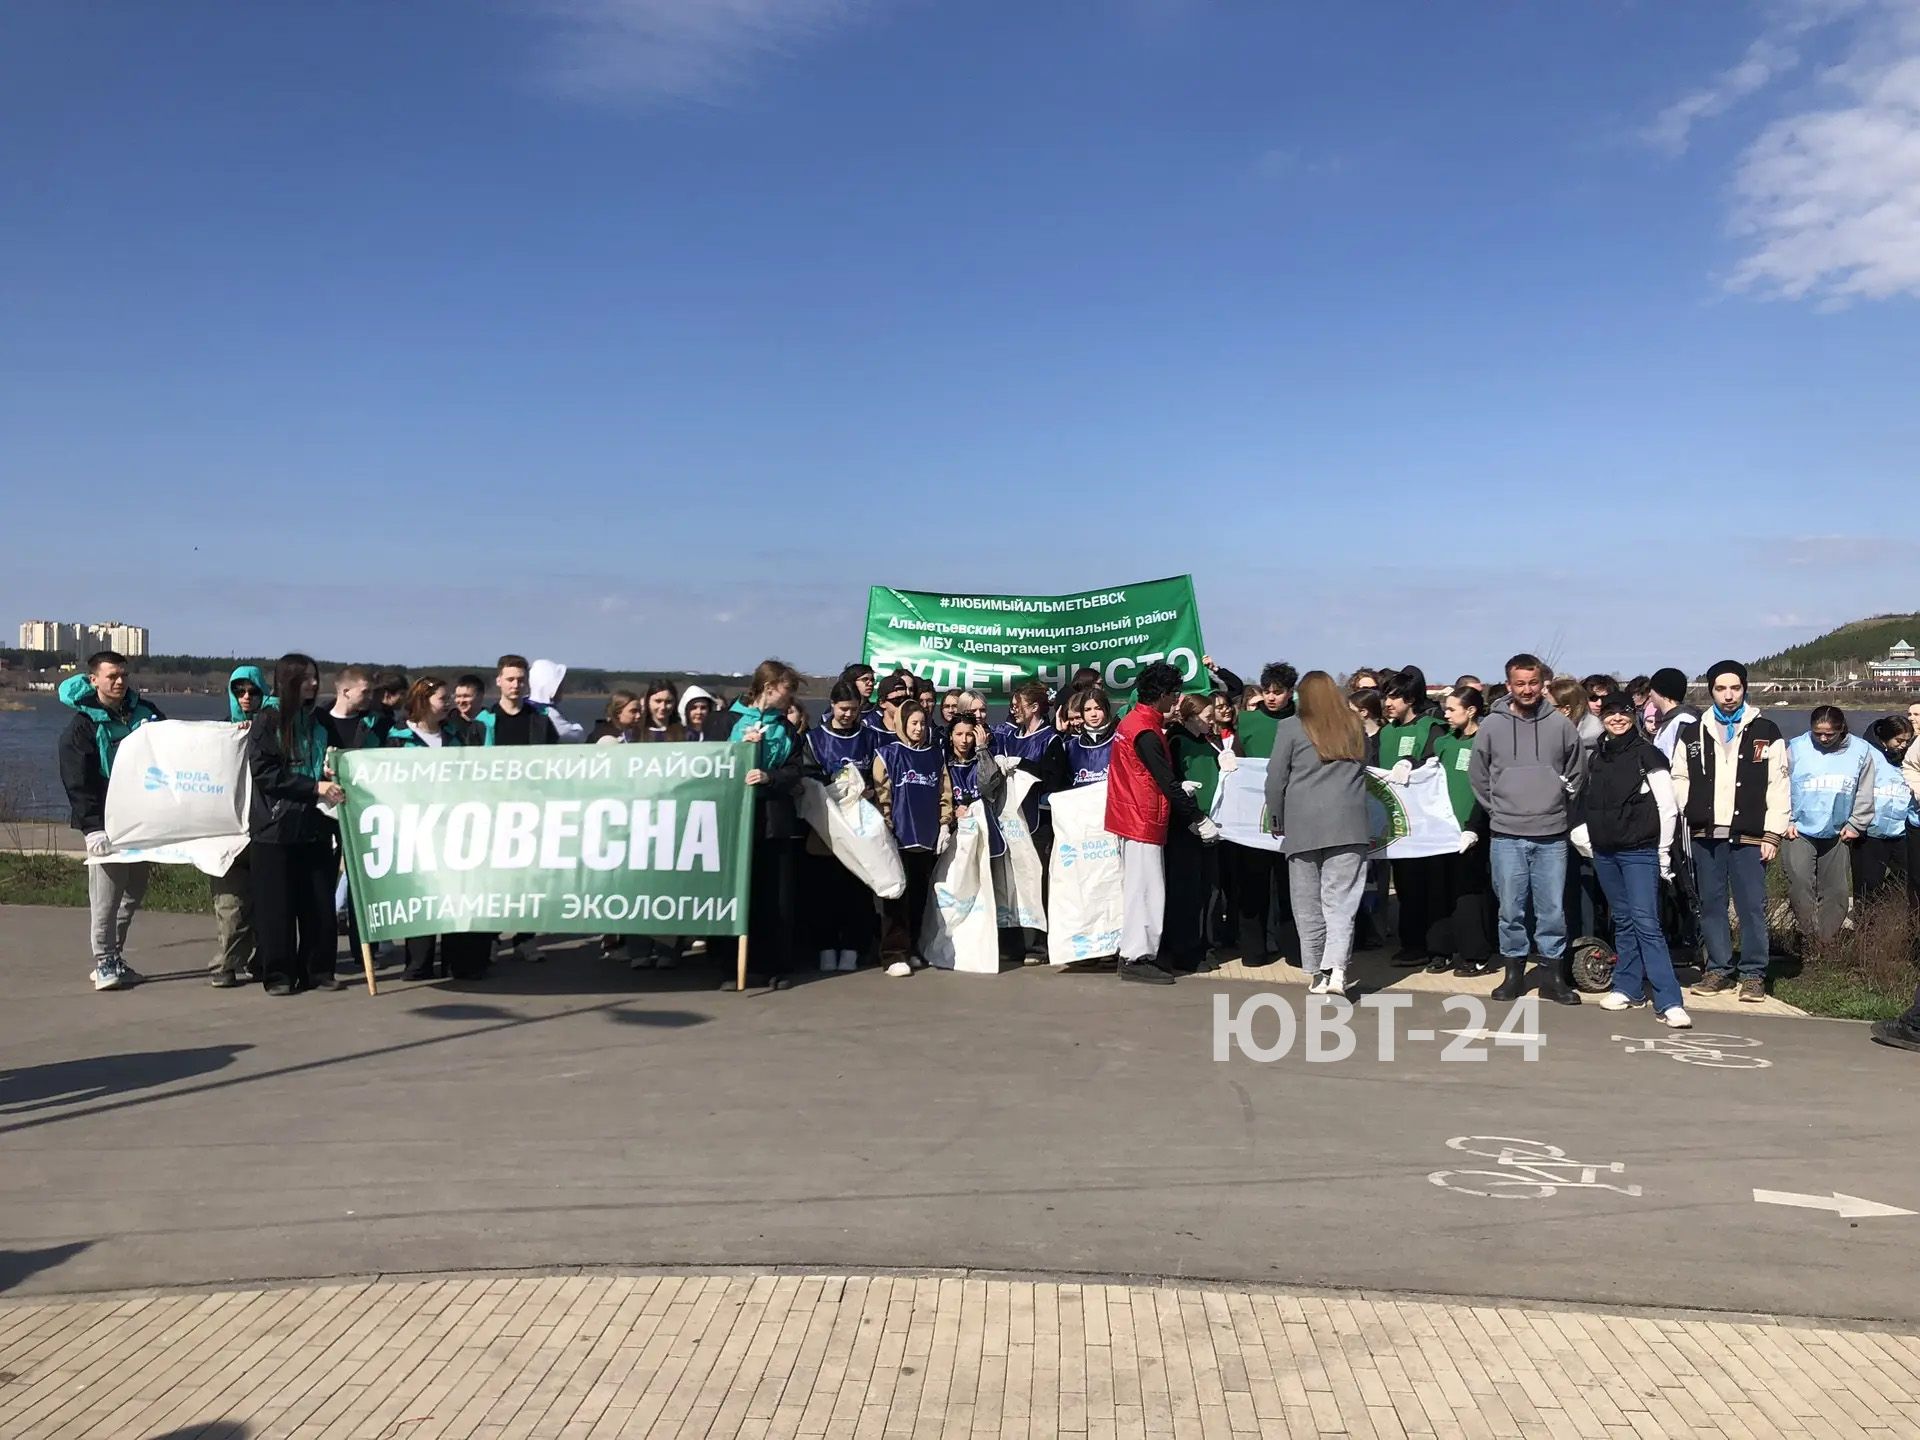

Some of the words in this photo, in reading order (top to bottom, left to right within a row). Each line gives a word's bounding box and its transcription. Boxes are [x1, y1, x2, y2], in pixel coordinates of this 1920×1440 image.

[940, 591, 1126, 613] #ЛЮБИМЫЙАЛЬМЕТЬЕВСК
[888, 616, 1001, 636] Альметьевский
[1006, 616, 1131, 639] муниципальный
[1136, 609, 1177, 628] район
[920, 635, 953, 649] МБУ
[958, 639, 1066, 656] «Департамент
[1072, 634, 1149, 652] экологии»
[352, 753, 611, 785] АЛЬМЕТЬЕВСКИЙ
[628, 752, 735, 779] РАЙОН
[359, 799, 720, 879] ЭКОВЕСНА
[368, 893, 546, 933] ДЕПАРТАМЕНТ
[561, 893, 737, 922] ЭКОЛОГИИ
